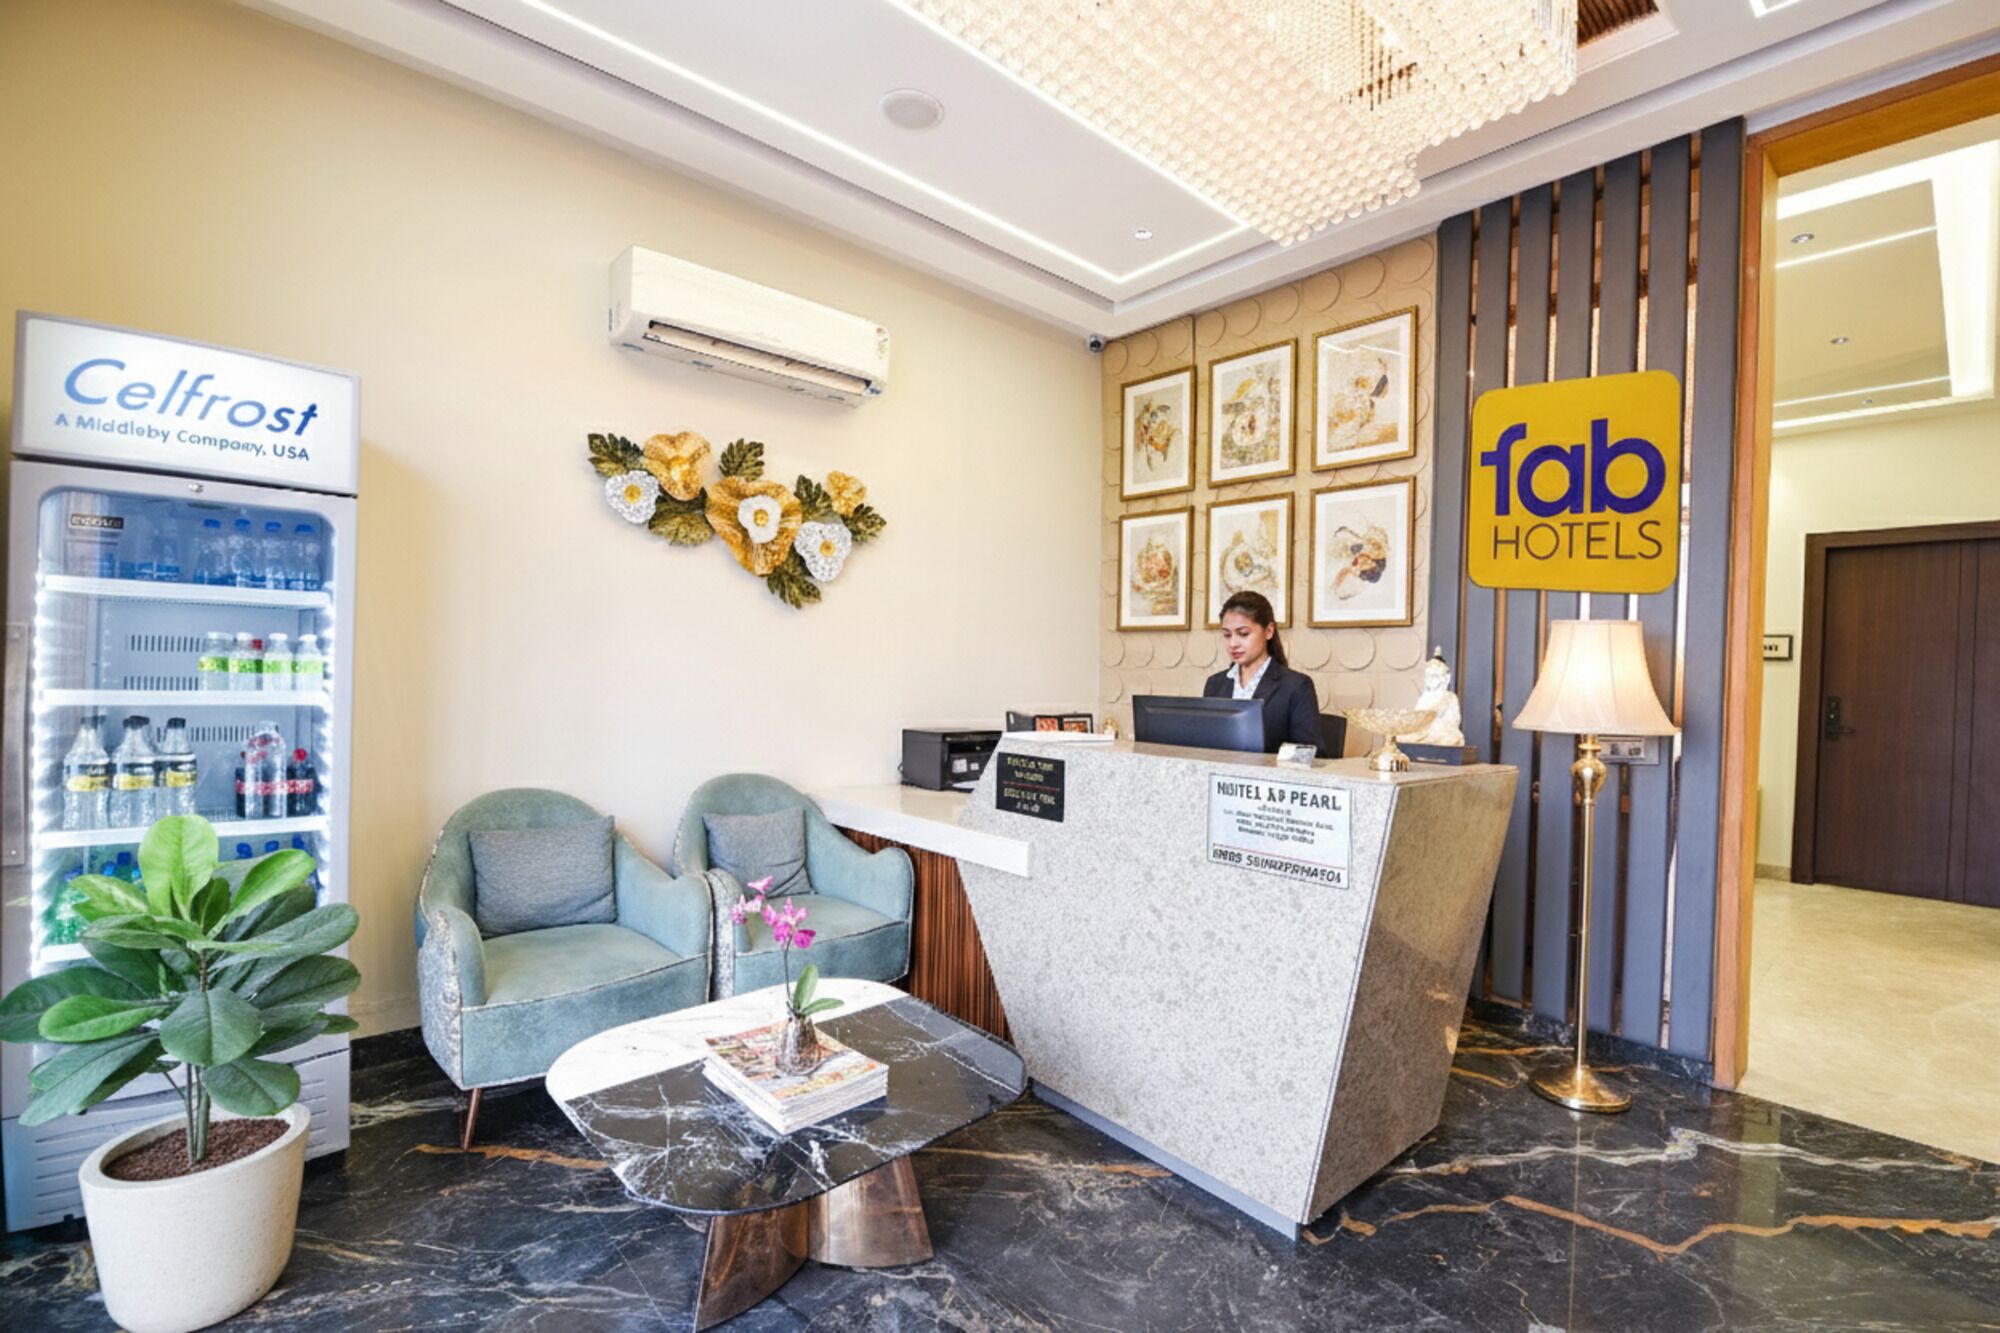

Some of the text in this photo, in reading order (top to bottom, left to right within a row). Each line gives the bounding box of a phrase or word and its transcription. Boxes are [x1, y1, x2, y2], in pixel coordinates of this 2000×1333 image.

[64, 358, 318, 436] Celfrost
[55, 413, 69, 427] A
[76, 415, 170, 443] Middleby
[273, 444, 310, 461] USA
[1480, 418, 1666, 518] fab
[1493, 520, 1663, 561] HOTELS
